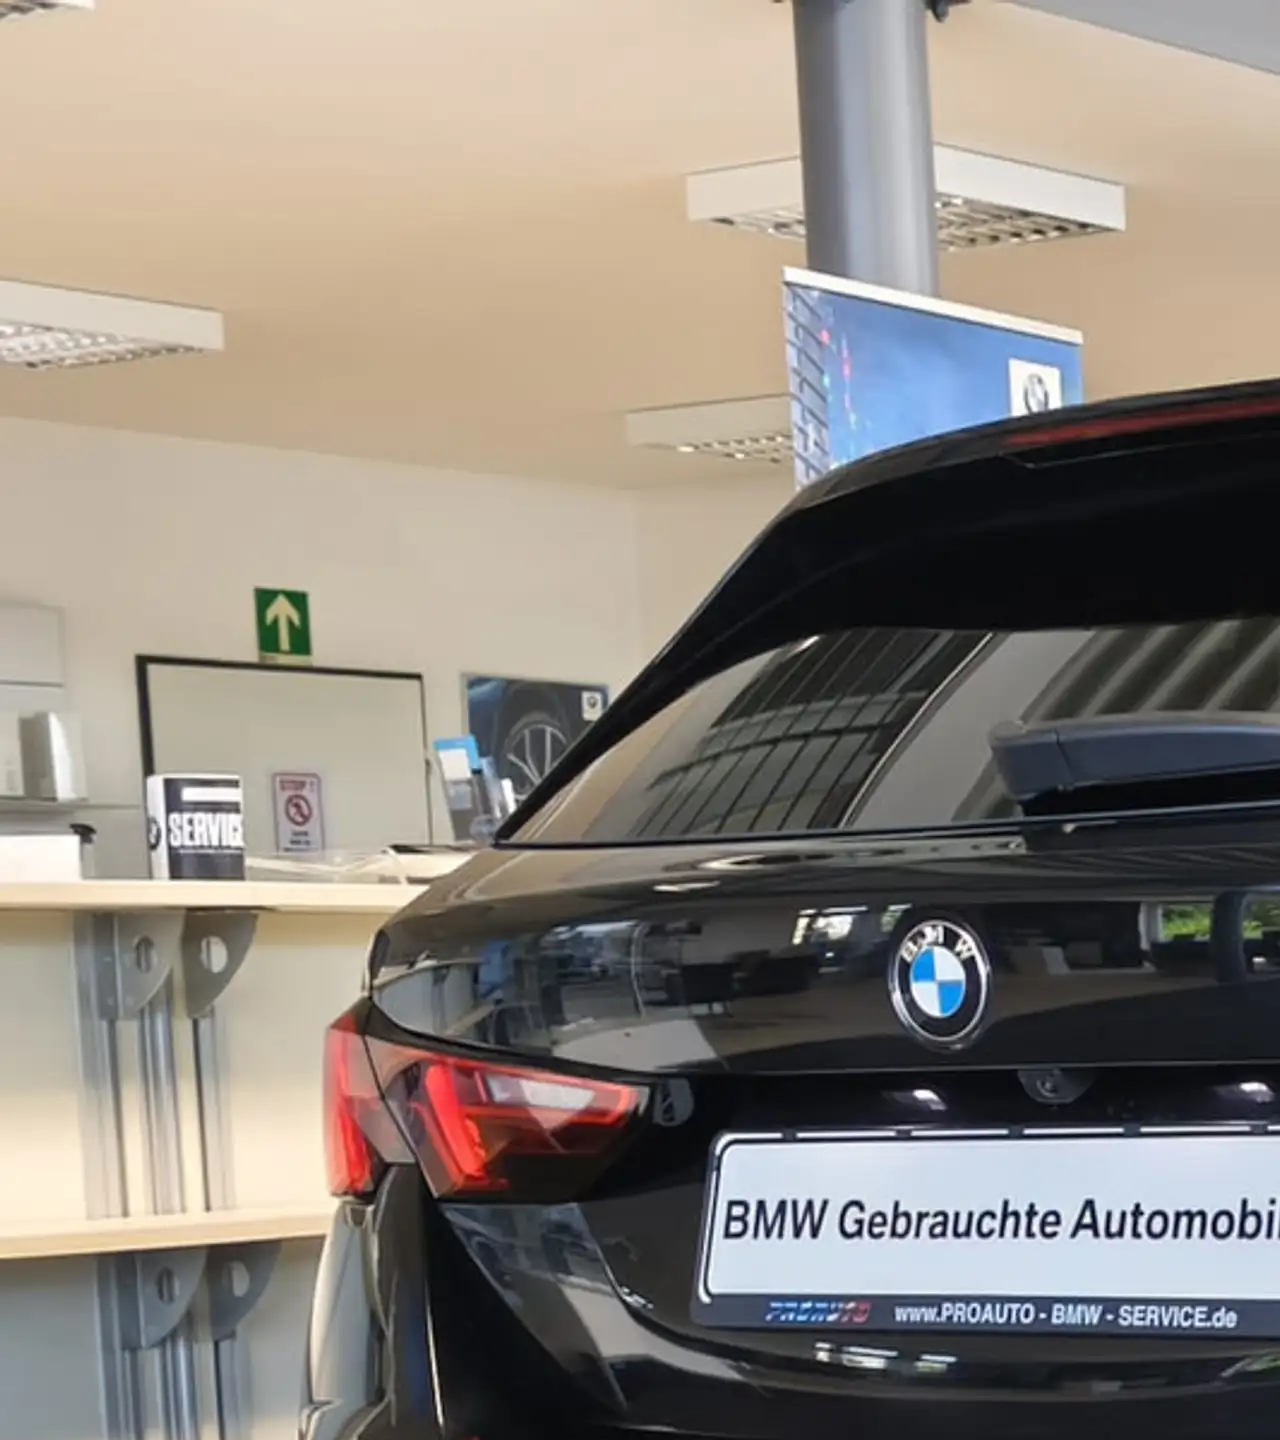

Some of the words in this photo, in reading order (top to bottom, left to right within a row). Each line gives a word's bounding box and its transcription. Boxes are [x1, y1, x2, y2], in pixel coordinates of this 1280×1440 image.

[901, 924, 976, 963] BMW
[723, 1198, 829, 1239] BMW
[838, 1197, 1061, 1239] Gebrauchte
[894, 1303, 1035, 1324] www.PROAUTO
[1051, 1303, 1102, 1325] BMW
[1118, 1304, 1238, 1328] SERVICE.de
